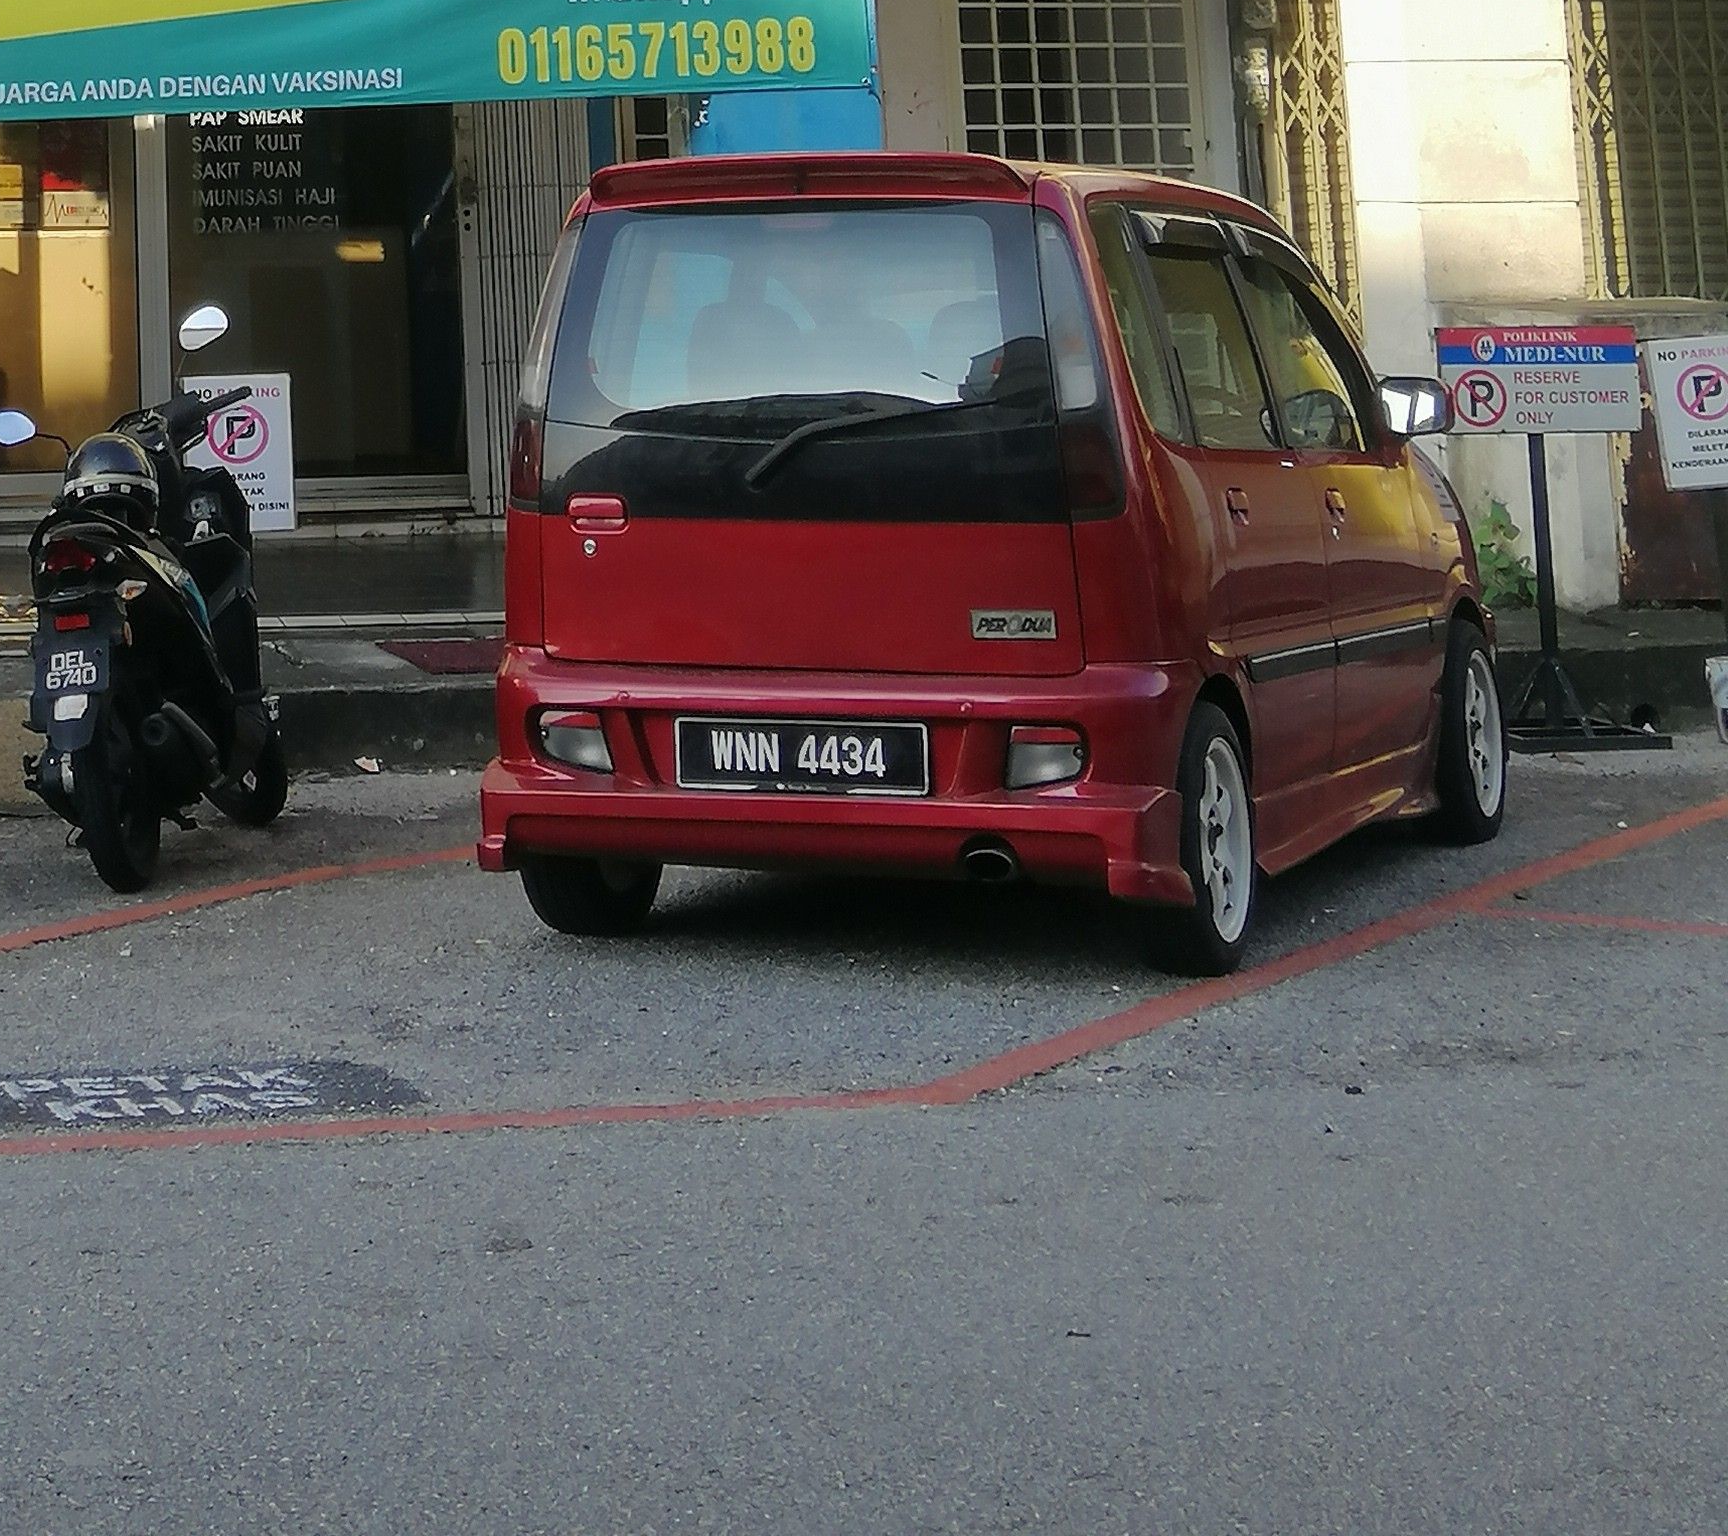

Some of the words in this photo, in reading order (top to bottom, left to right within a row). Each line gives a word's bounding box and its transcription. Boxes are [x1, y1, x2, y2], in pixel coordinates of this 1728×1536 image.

[496, 15, 817, 86] 01165713988
[80, 77, 152, 102] ANDA
[160, 73, 267, 98] DENGAN
[271, 66, 404, 93] VAKSINASI
[189, 110, 228, 127] PAP
[238, 108, 304, 126] SMEAR
[191, 134, 243, 153] SAKIT
[255, 133, 303, 152] KULIT
[191, 161, 241, 180] SAKIT
[252, 160, 302, 178] PUAN
[191, 188, 283, 208] IMUNISASI
[294, 187, 337, 205] HAJI
[1502, 331, 1578, 343] POLIKLINIK
[1502, 346, 1606, 363] MEDI-NUR
[1657, 350, 1677, 362] NO
[1513, 371, 1581, 384] RESERVE
[1514, 391, 1545, 405] FOR
[1549, 390, 1629, 405] CUSTOMER
[1515, 411, 1554, 425] ONLY
[258, 502, 290, 512] DISINI
[710, 729, 780, 773] WNN
[797, 734, 887, 778] 4434
